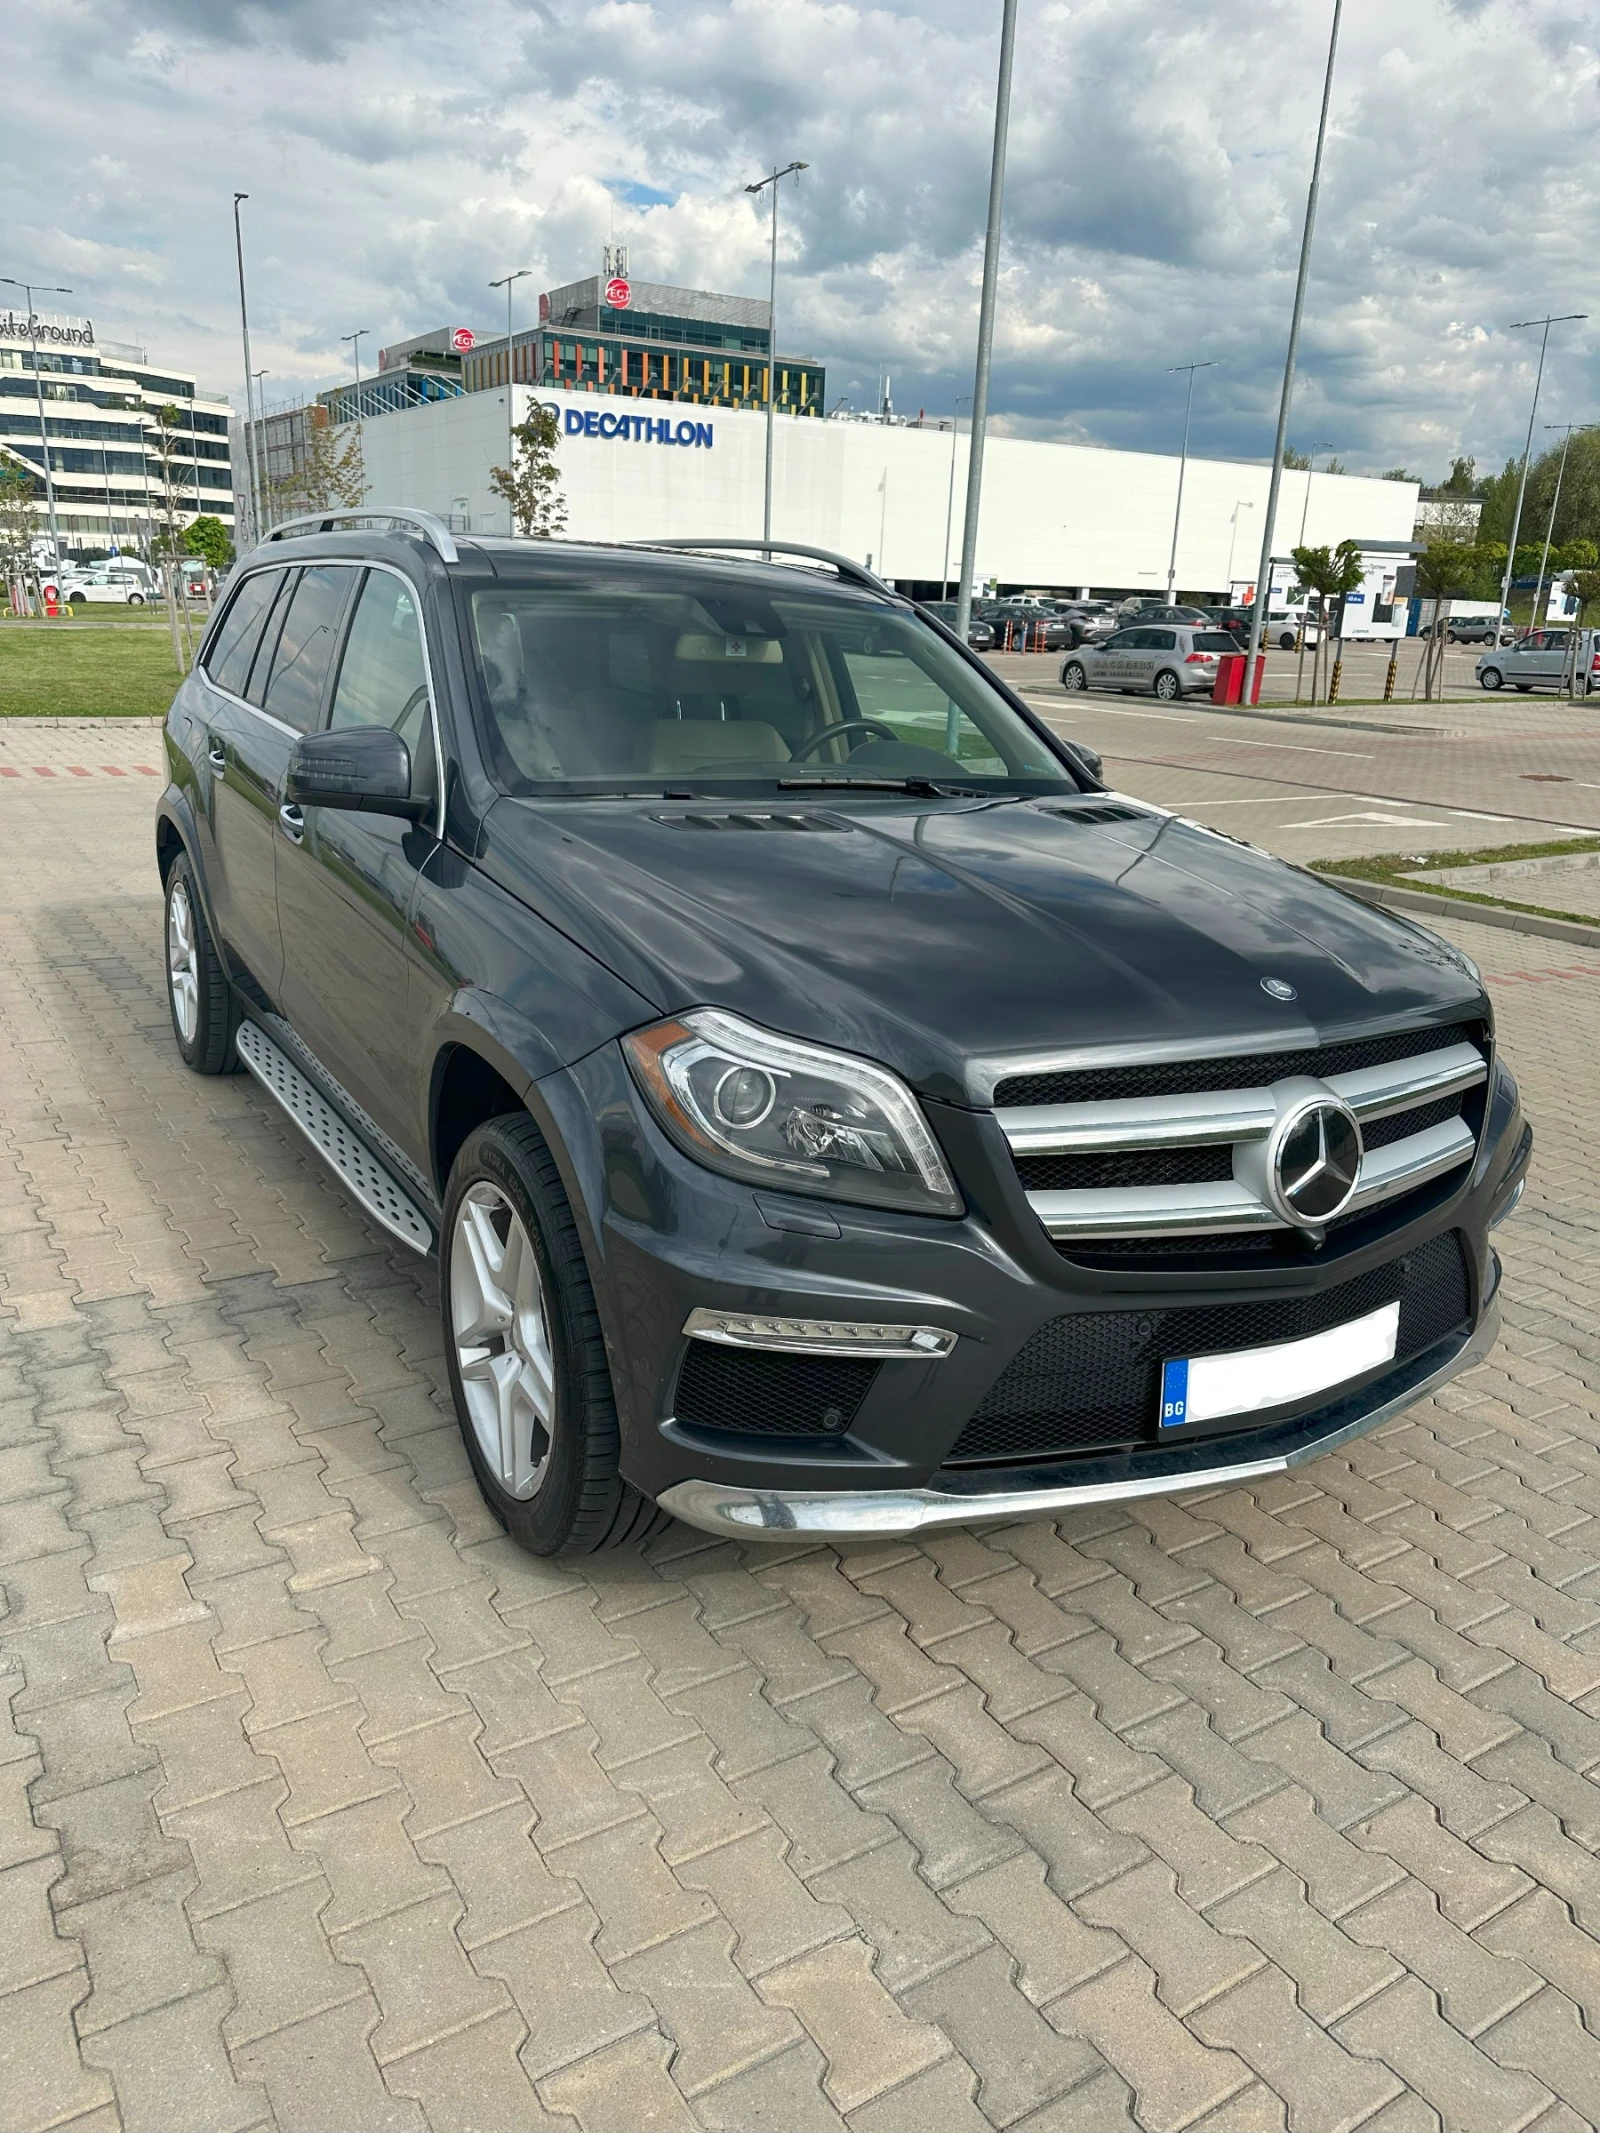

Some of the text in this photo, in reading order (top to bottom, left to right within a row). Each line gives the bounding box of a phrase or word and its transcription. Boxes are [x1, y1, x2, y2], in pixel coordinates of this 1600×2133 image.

[457, 335, 474, 346] EGT
[565, 408, 713, 448] DECATHLON
[1093, 659, 1154, 670] ВАСИЛЕВИ
[483, 1149, 545, 1262] HYDRA EDGE TOUR
[1165, 1400, 1184, 1418] BG
